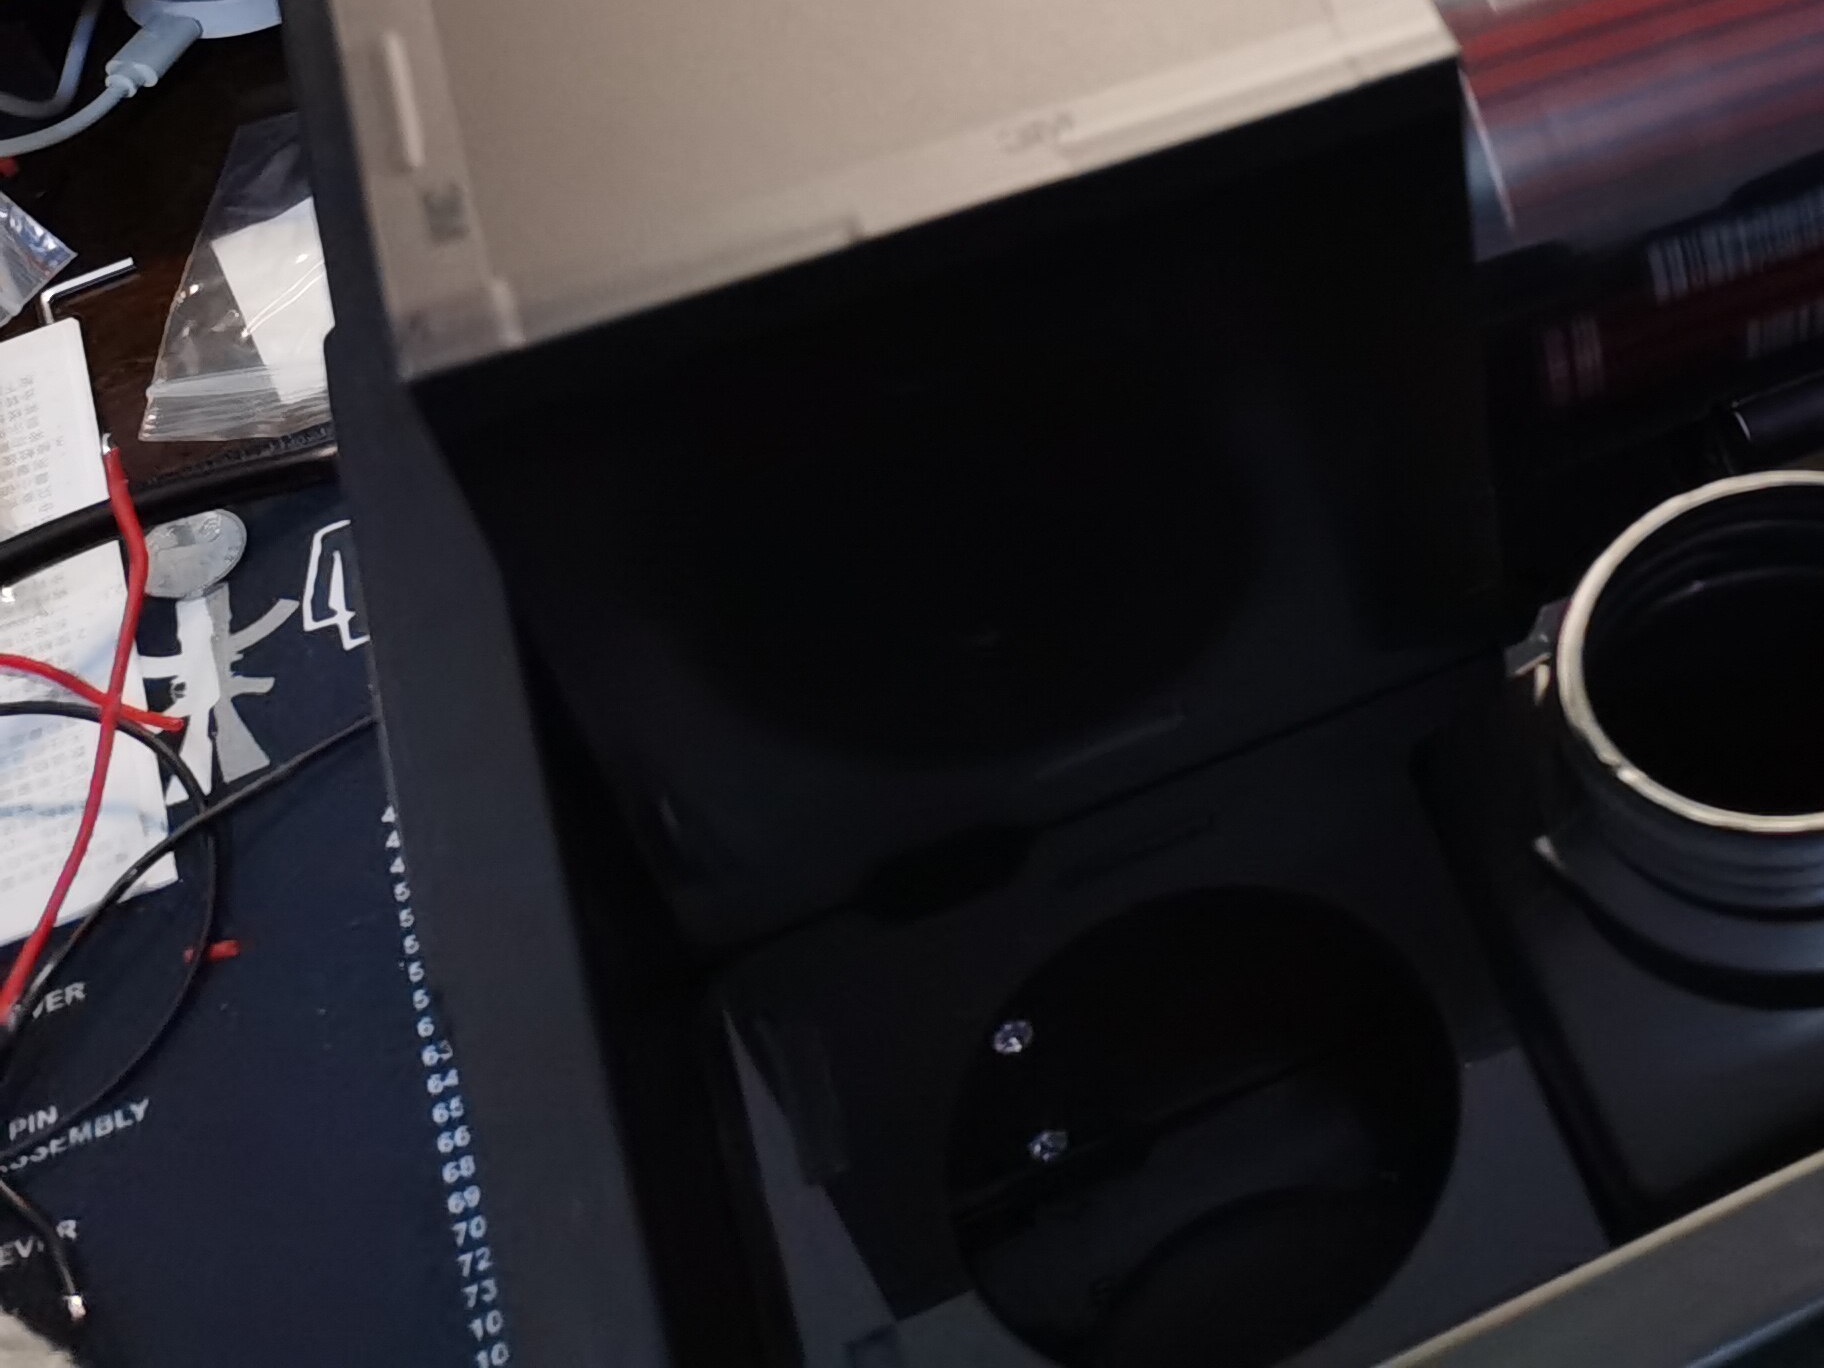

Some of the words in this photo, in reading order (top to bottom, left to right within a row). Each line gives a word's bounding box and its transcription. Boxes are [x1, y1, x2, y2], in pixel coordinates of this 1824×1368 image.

[8, 1105, 59, 1141] PIN
[452, 1214, 487, 1248] 70
[456, 1246, 493, 1278] 72
